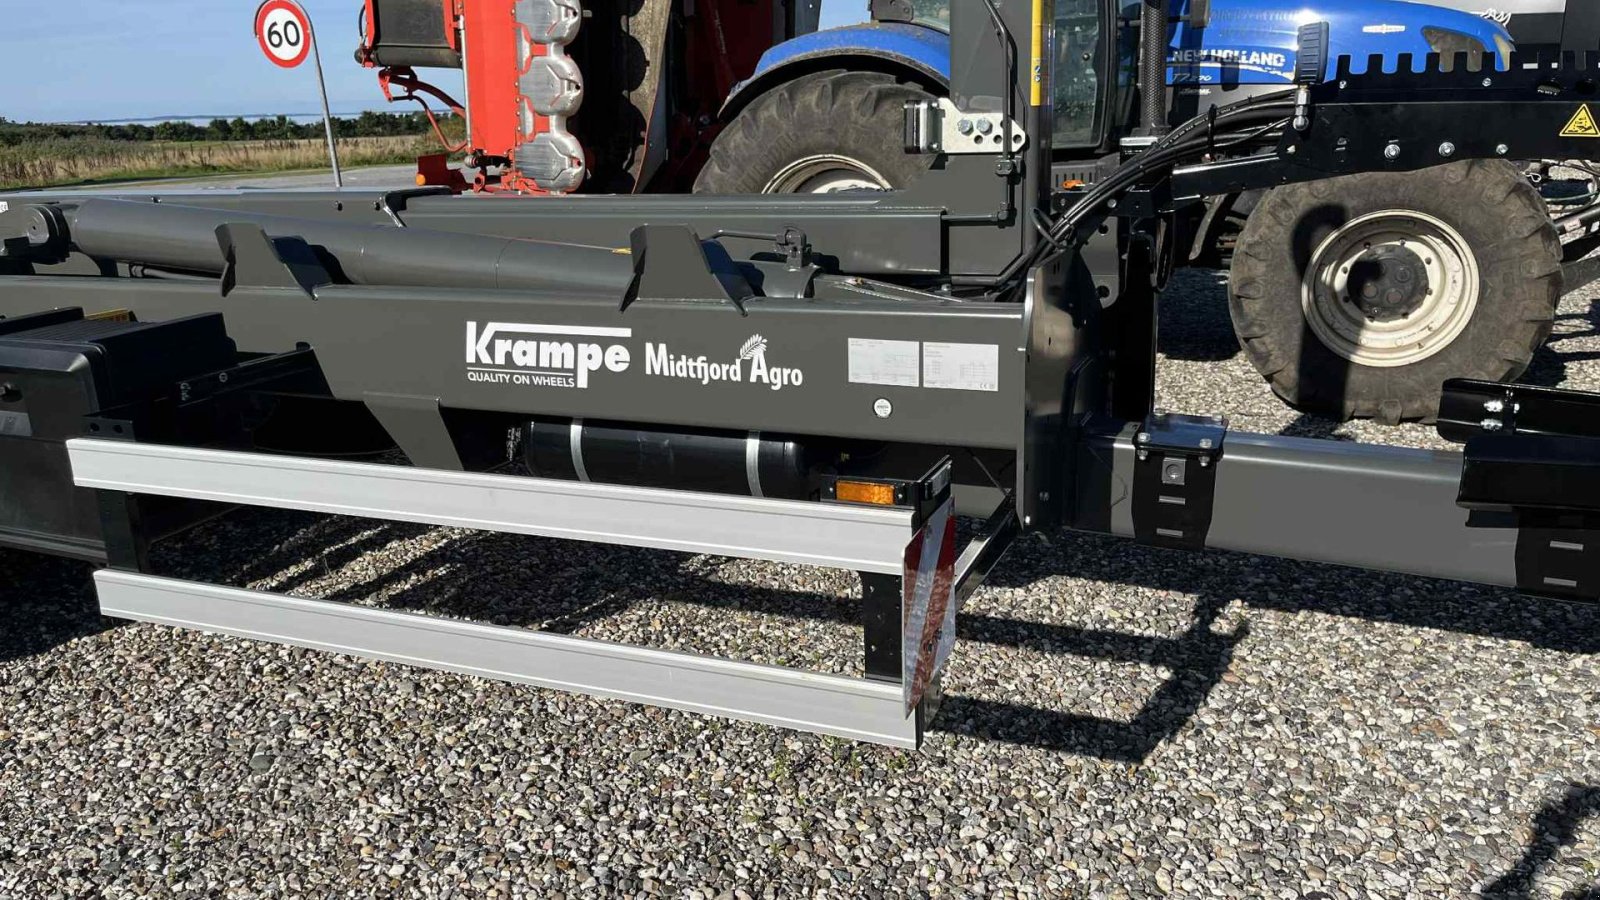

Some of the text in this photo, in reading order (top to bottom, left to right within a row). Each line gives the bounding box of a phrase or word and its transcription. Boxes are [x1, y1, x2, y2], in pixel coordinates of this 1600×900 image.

[267, 20, 301, 48] 60
[1172, 49, 1286, 67] NEW HOLLAND
[466, 321, 632, 388] Krampe
[645, 342, 742, 385] Midtfjord
[749, 347, 803, 391] Agro
[467, 371, 575, 388] QUALITY ON WHEELS
